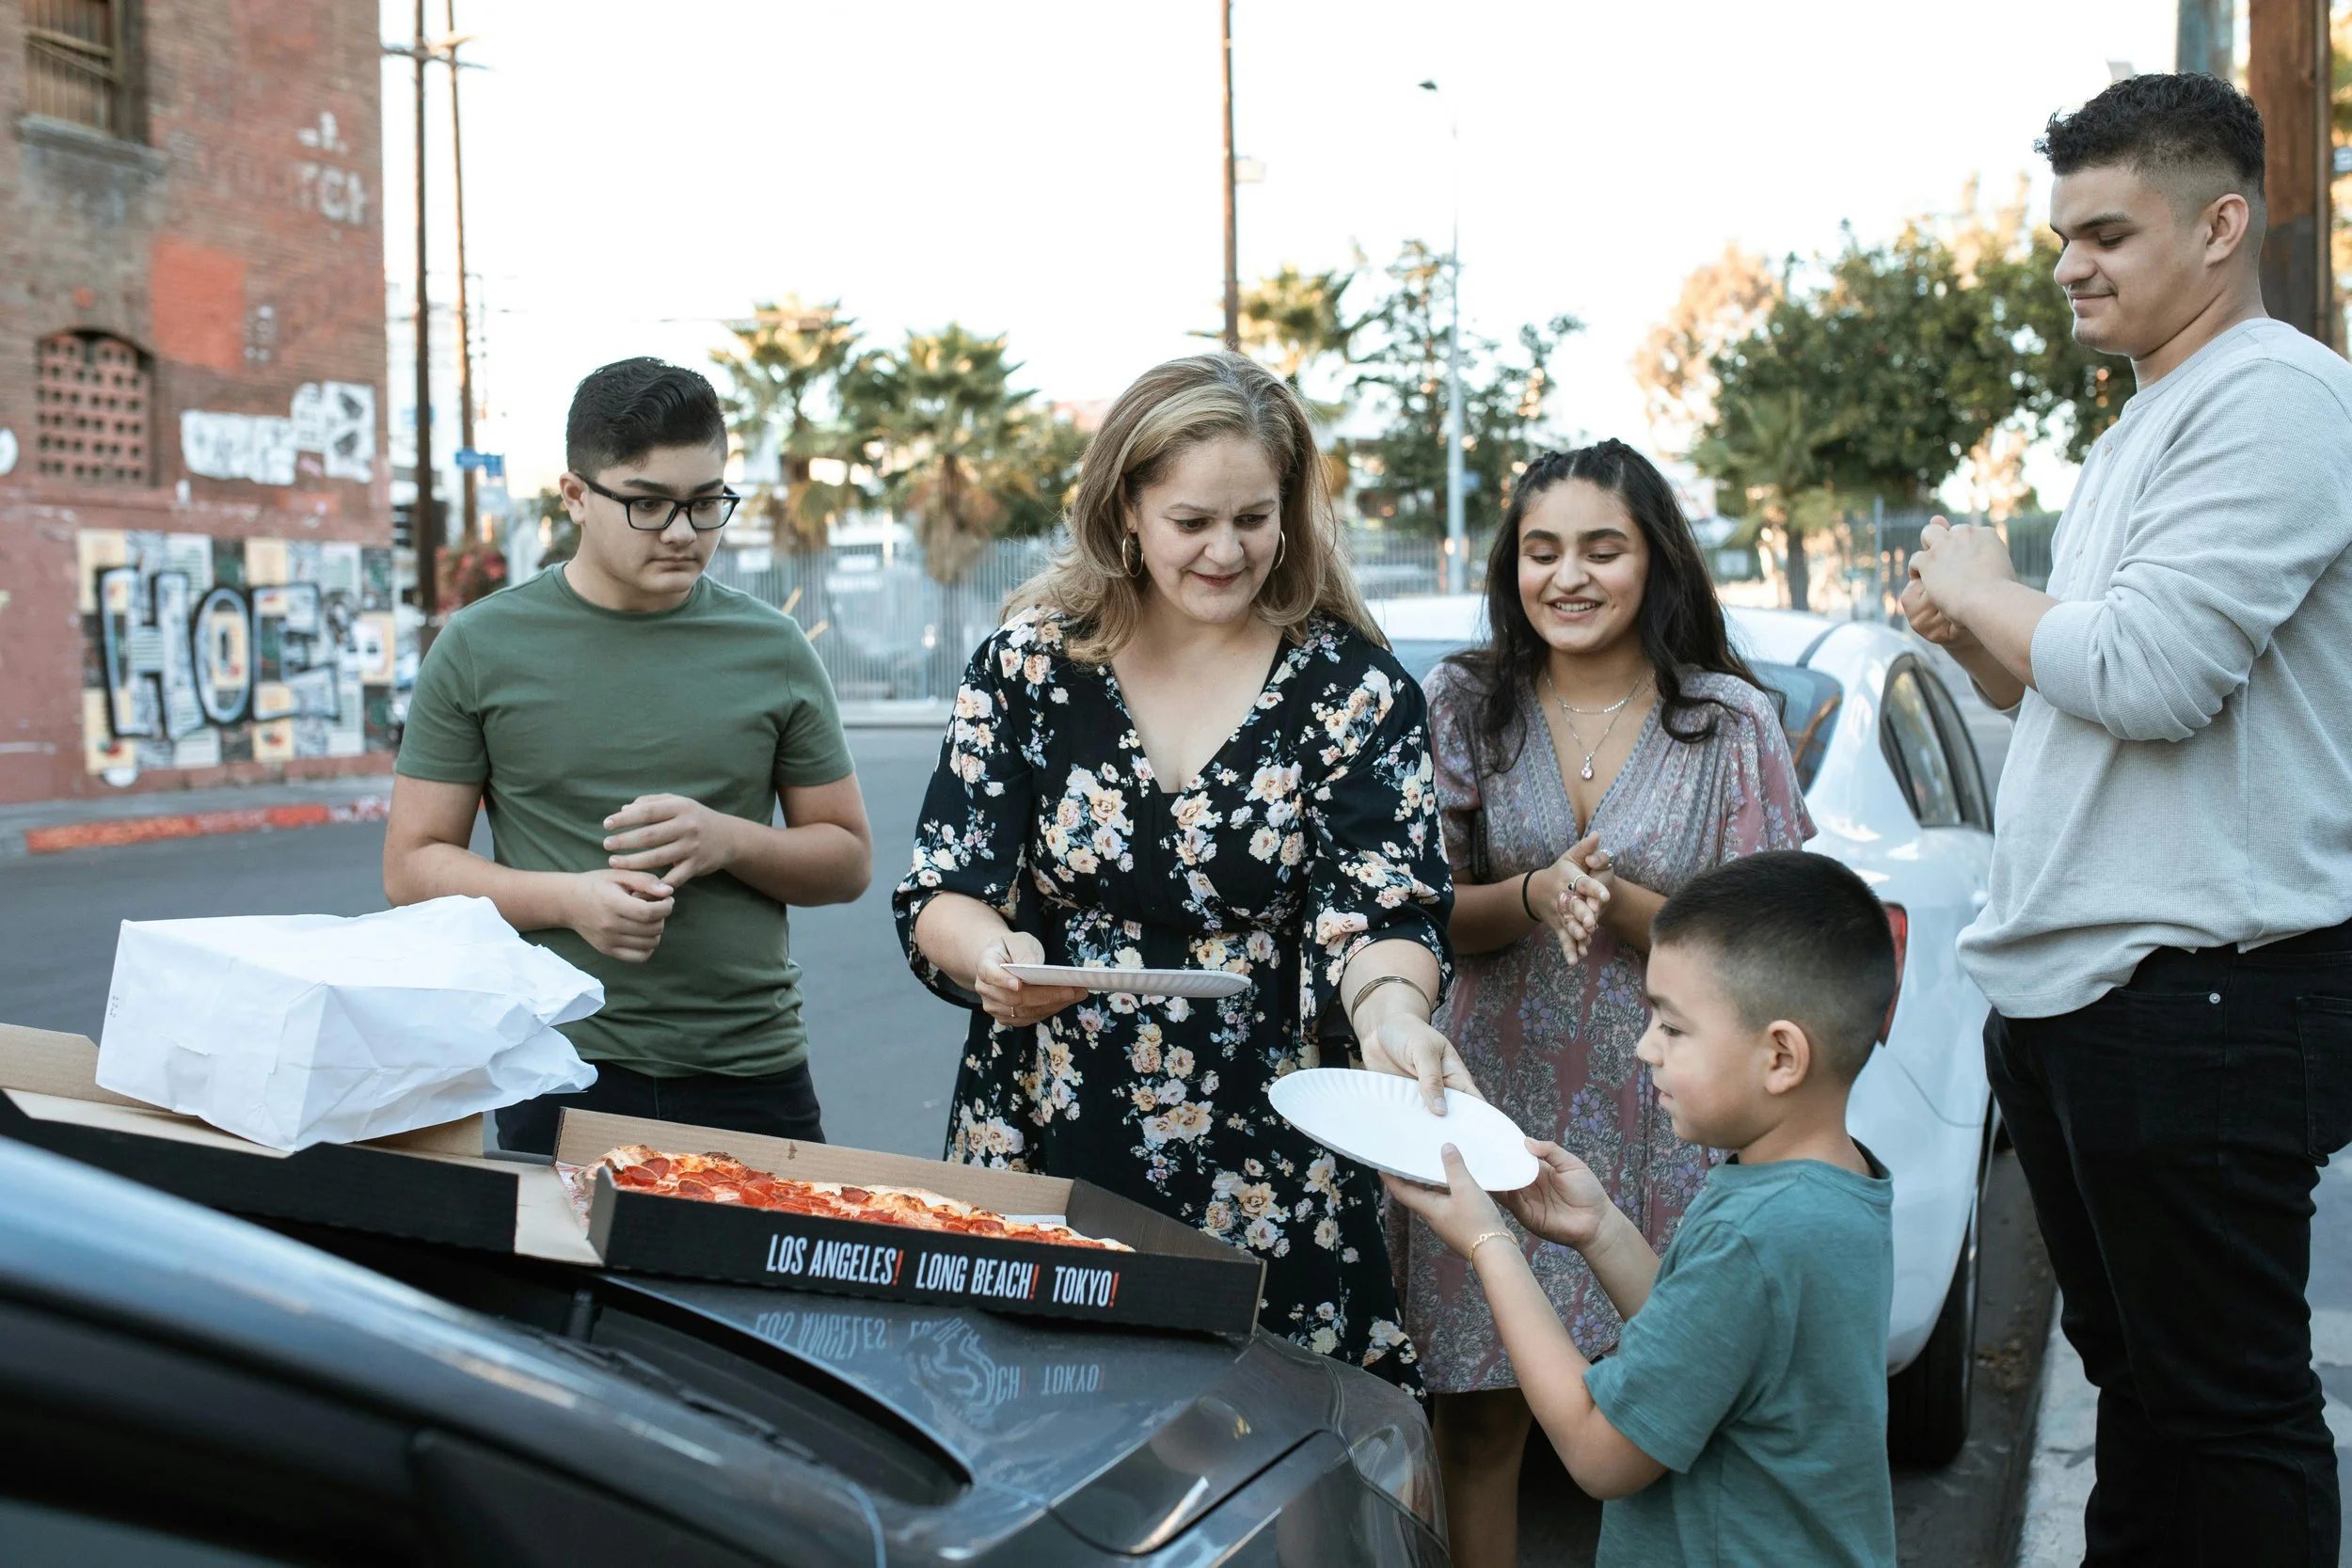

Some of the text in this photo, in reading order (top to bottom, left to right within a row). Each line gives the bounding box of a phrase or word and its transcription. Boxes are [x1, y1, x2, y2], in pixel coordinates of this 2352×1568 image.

[766, 1233, 1120, 1308] LOS ANGELES! LONG BEACH! TOKYO!
